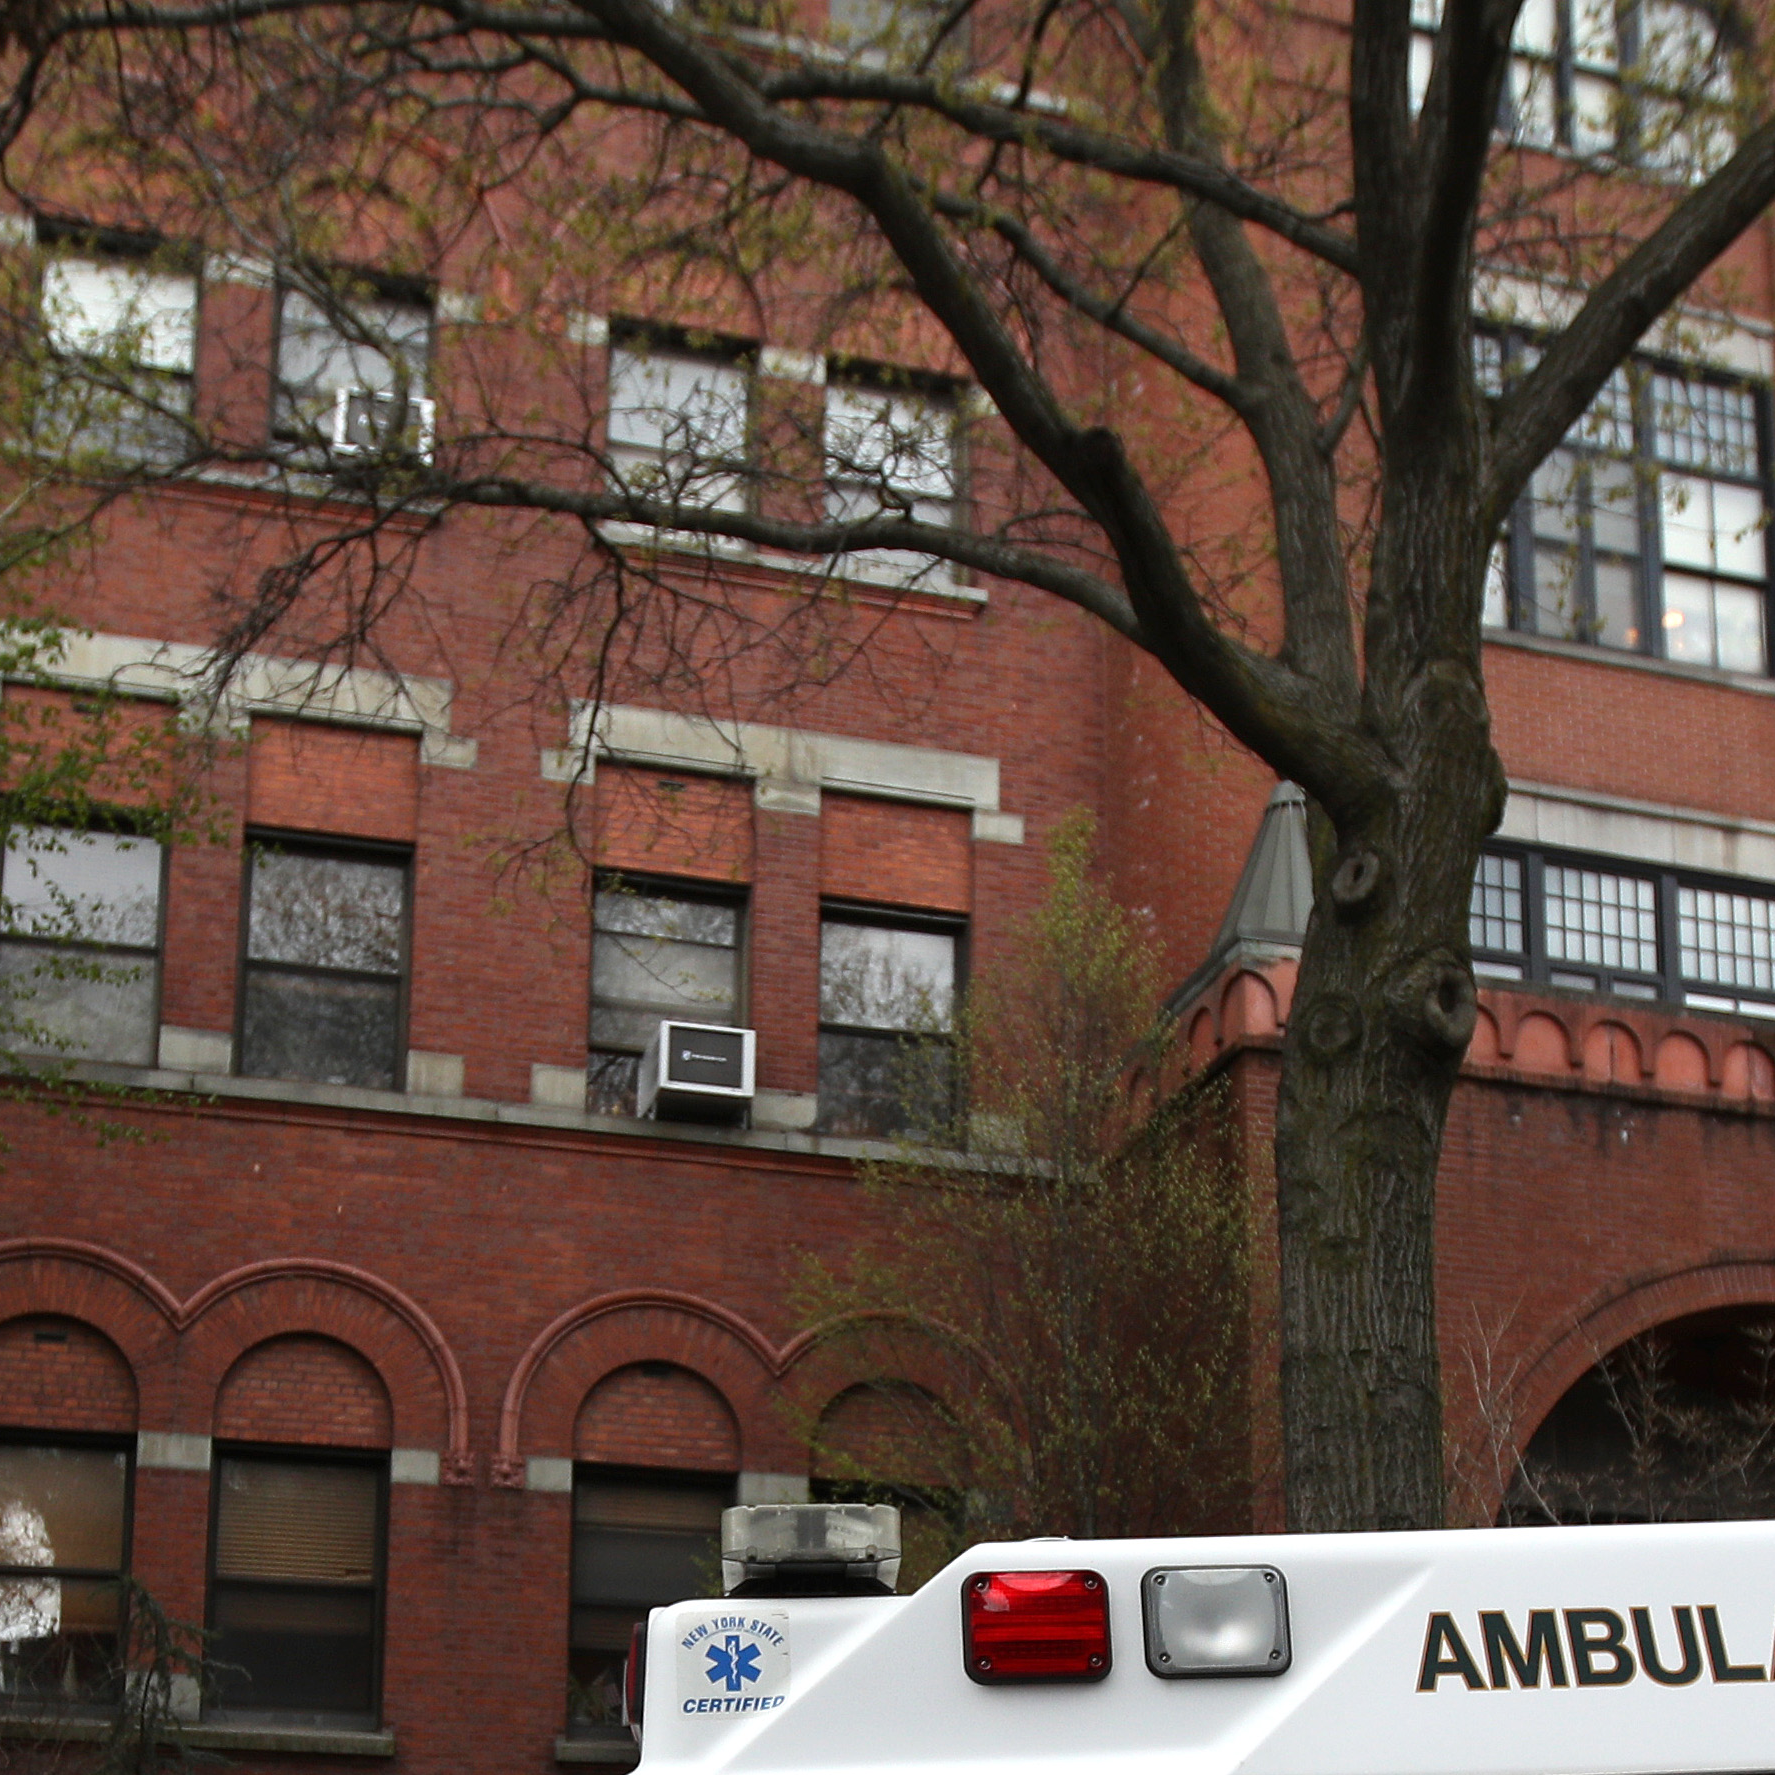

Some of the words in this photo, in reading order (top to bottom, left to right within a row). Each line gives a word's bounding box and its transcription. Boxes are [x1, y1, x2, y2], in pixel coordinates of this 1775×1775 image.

[681, 1624, 708, 1650] NEW
[712, 1616, 746, 1630] YORK
[749, 1619, 784, 1647] STATE
[682, 1695, 785, 1714] CERTIFIED
